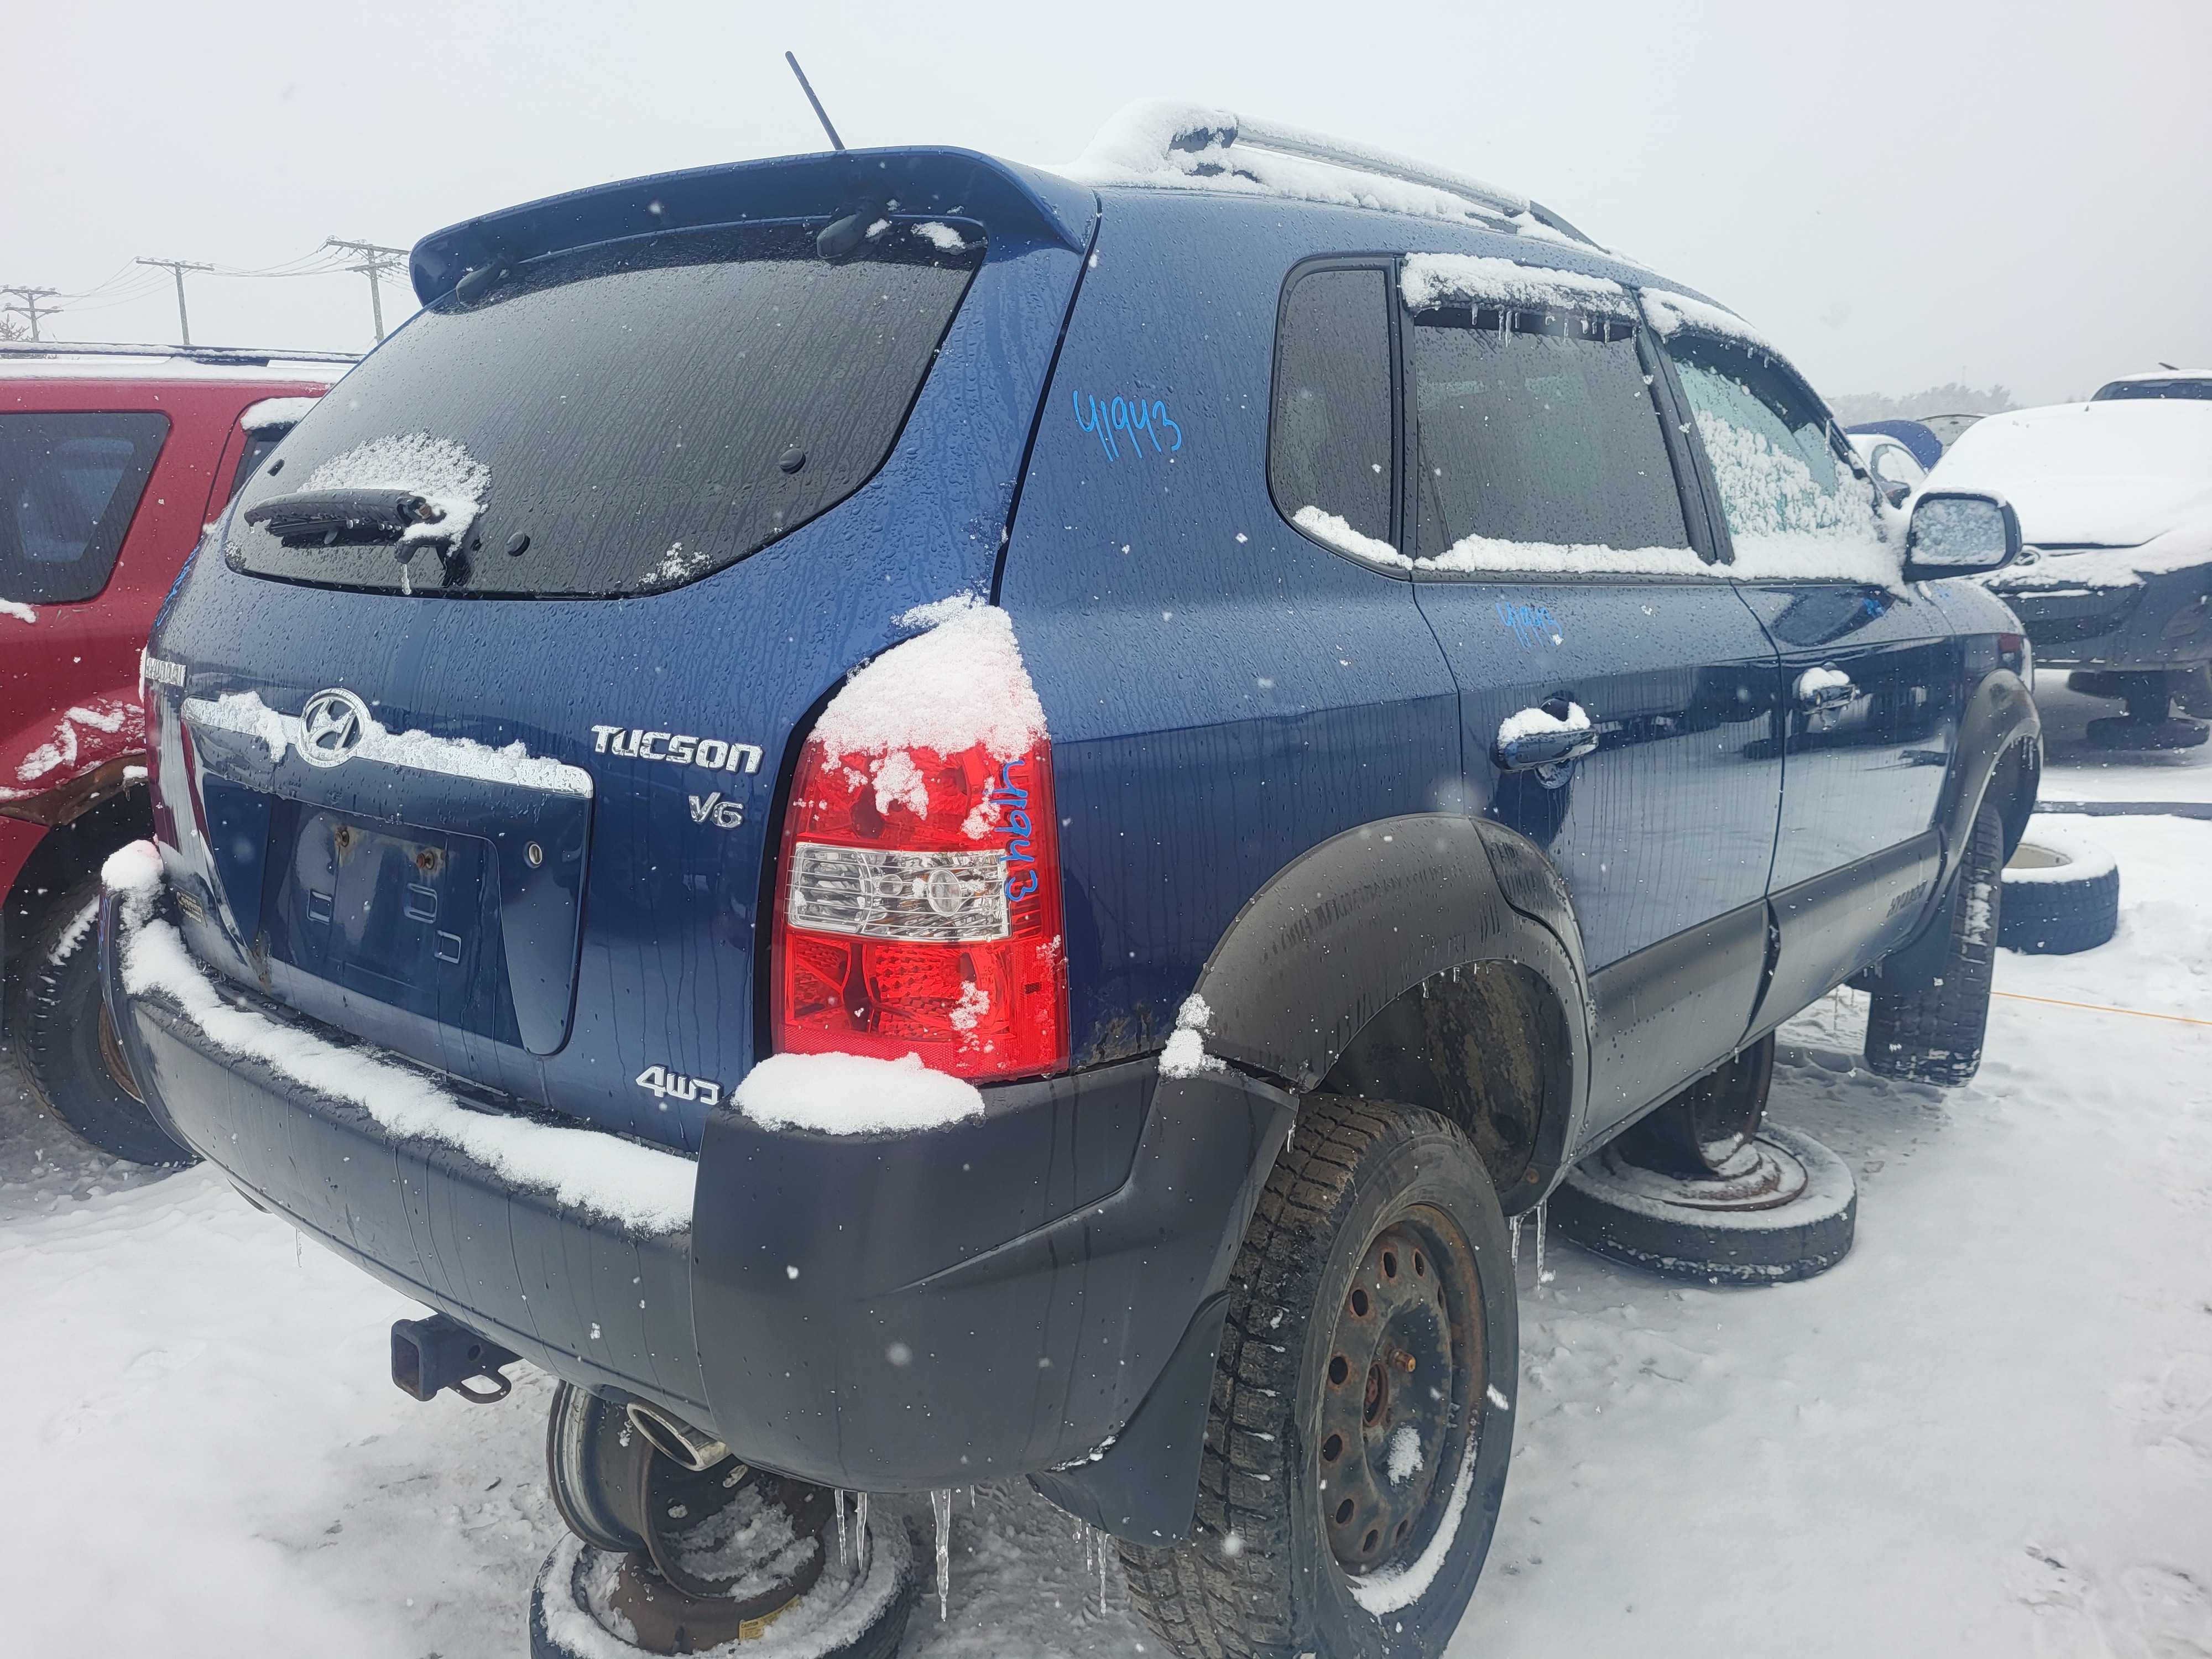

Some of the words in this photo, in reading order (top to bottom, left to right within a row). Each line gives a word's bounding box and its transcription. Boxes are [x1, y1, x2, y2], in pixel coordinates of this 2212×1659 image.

[1073, 389, 1182, 462] 41943
[590, 724, 764, 774] TUCSON
[688, 791, 744, 828] V6
[635, 1065, 722, 1105] 4WD
